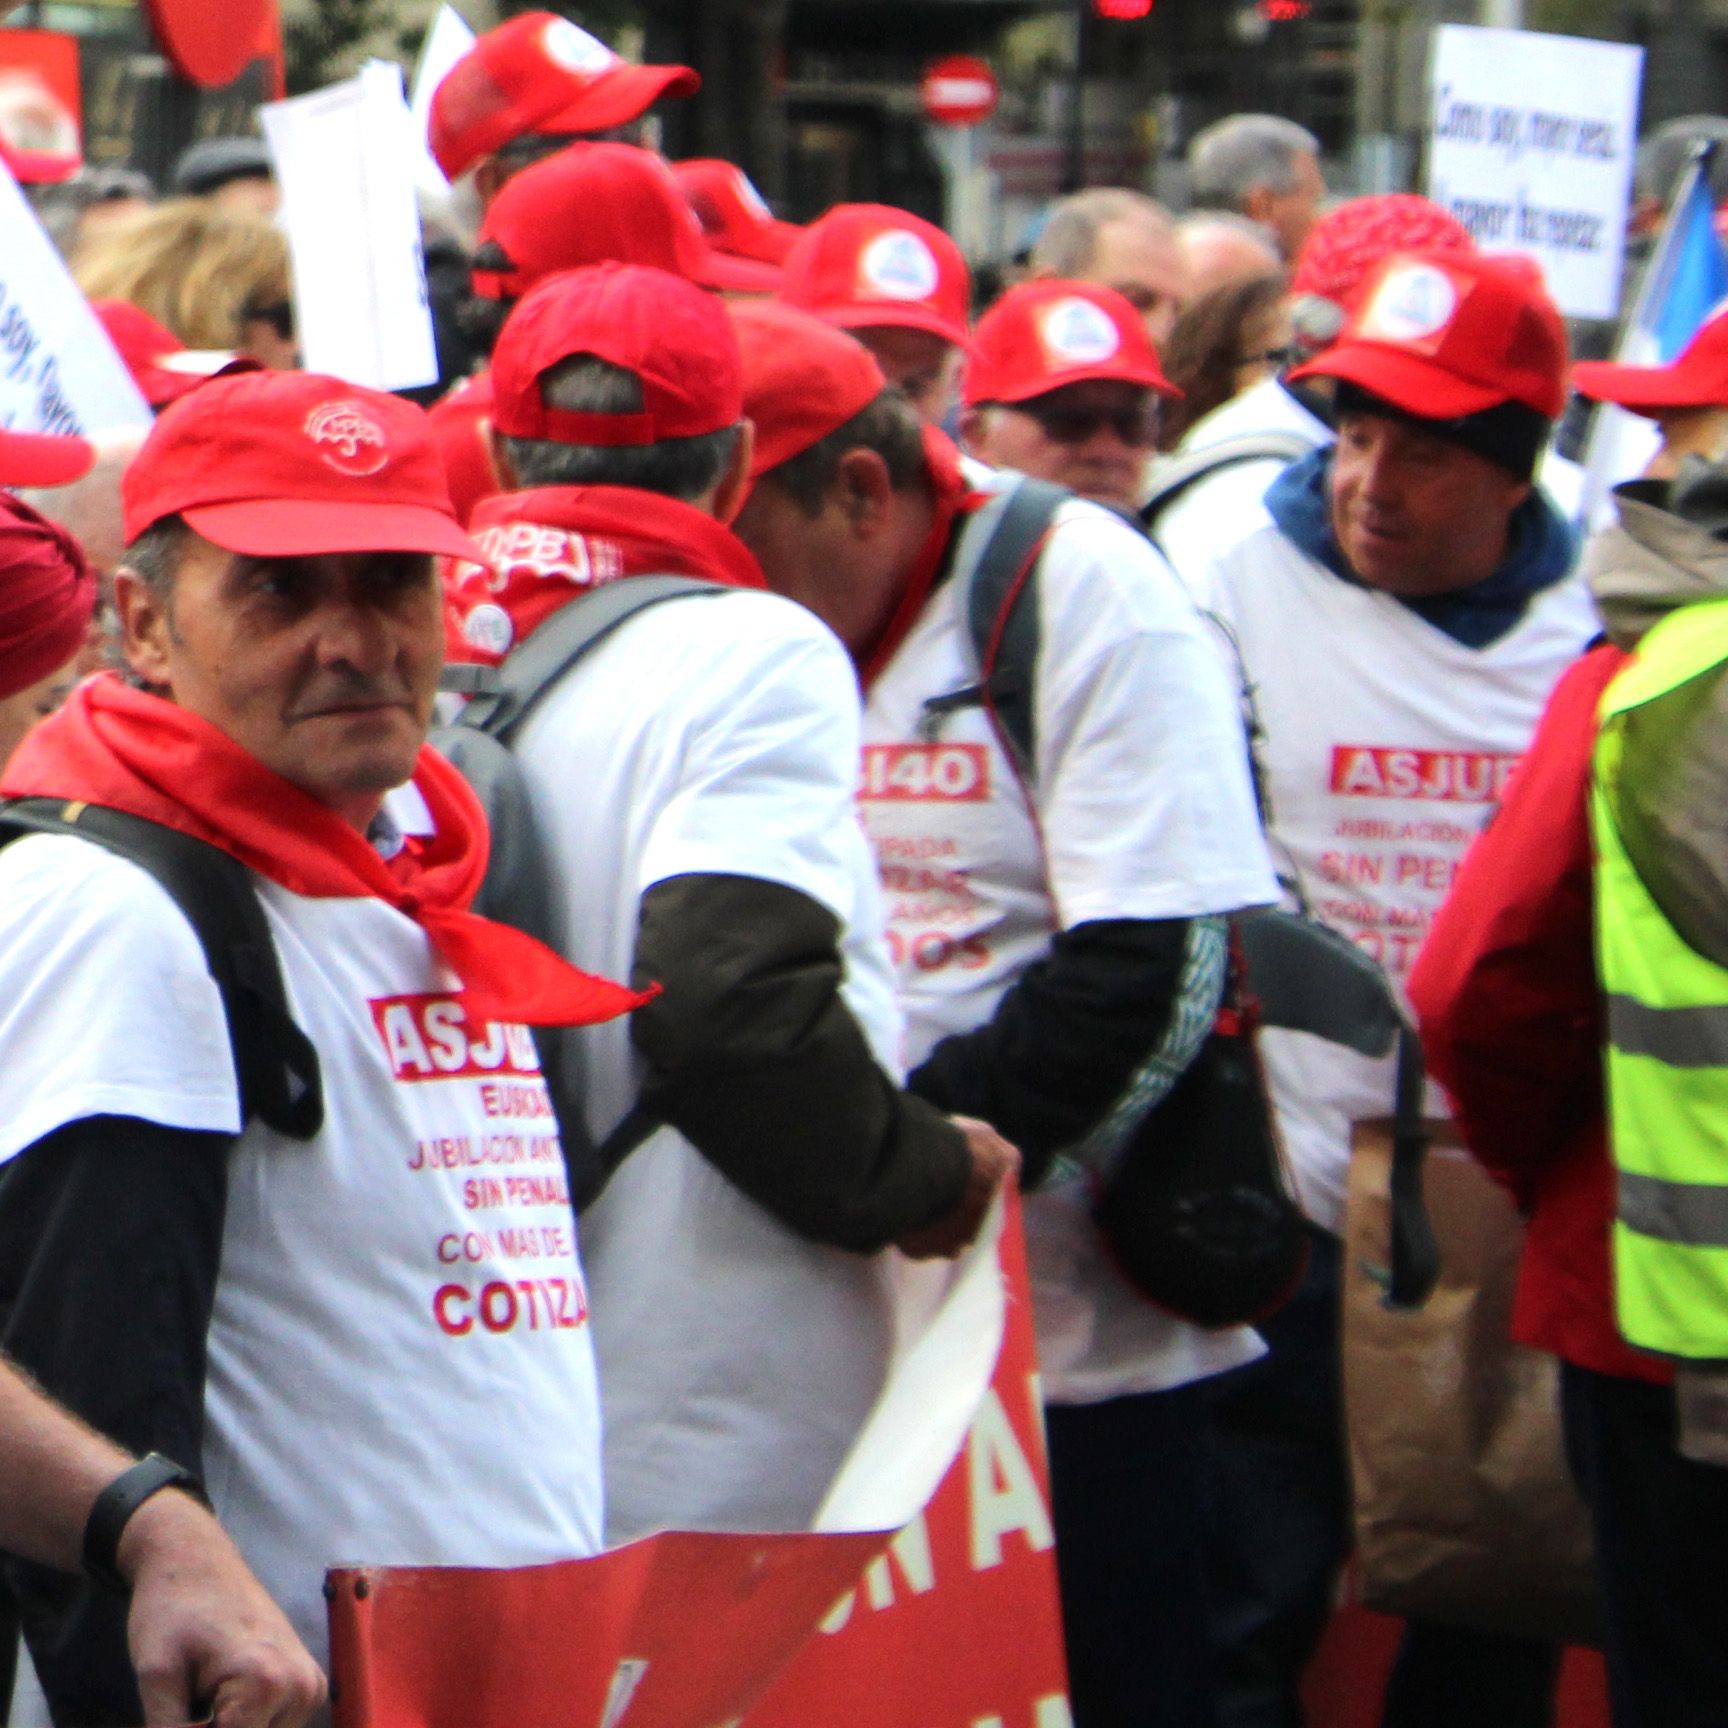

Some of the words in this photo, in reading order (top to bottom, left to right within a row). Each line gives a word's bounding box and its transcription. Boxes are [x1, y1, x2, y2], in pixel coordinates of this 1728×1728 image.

[860, 749, 977, 796] I40
[1318, 849, 1383, 885] SIN
[462, 1179, 503, 1211] SIN
[437, 1231, 496, 1264] CON
[540, 1228, 570, 1257] DE
